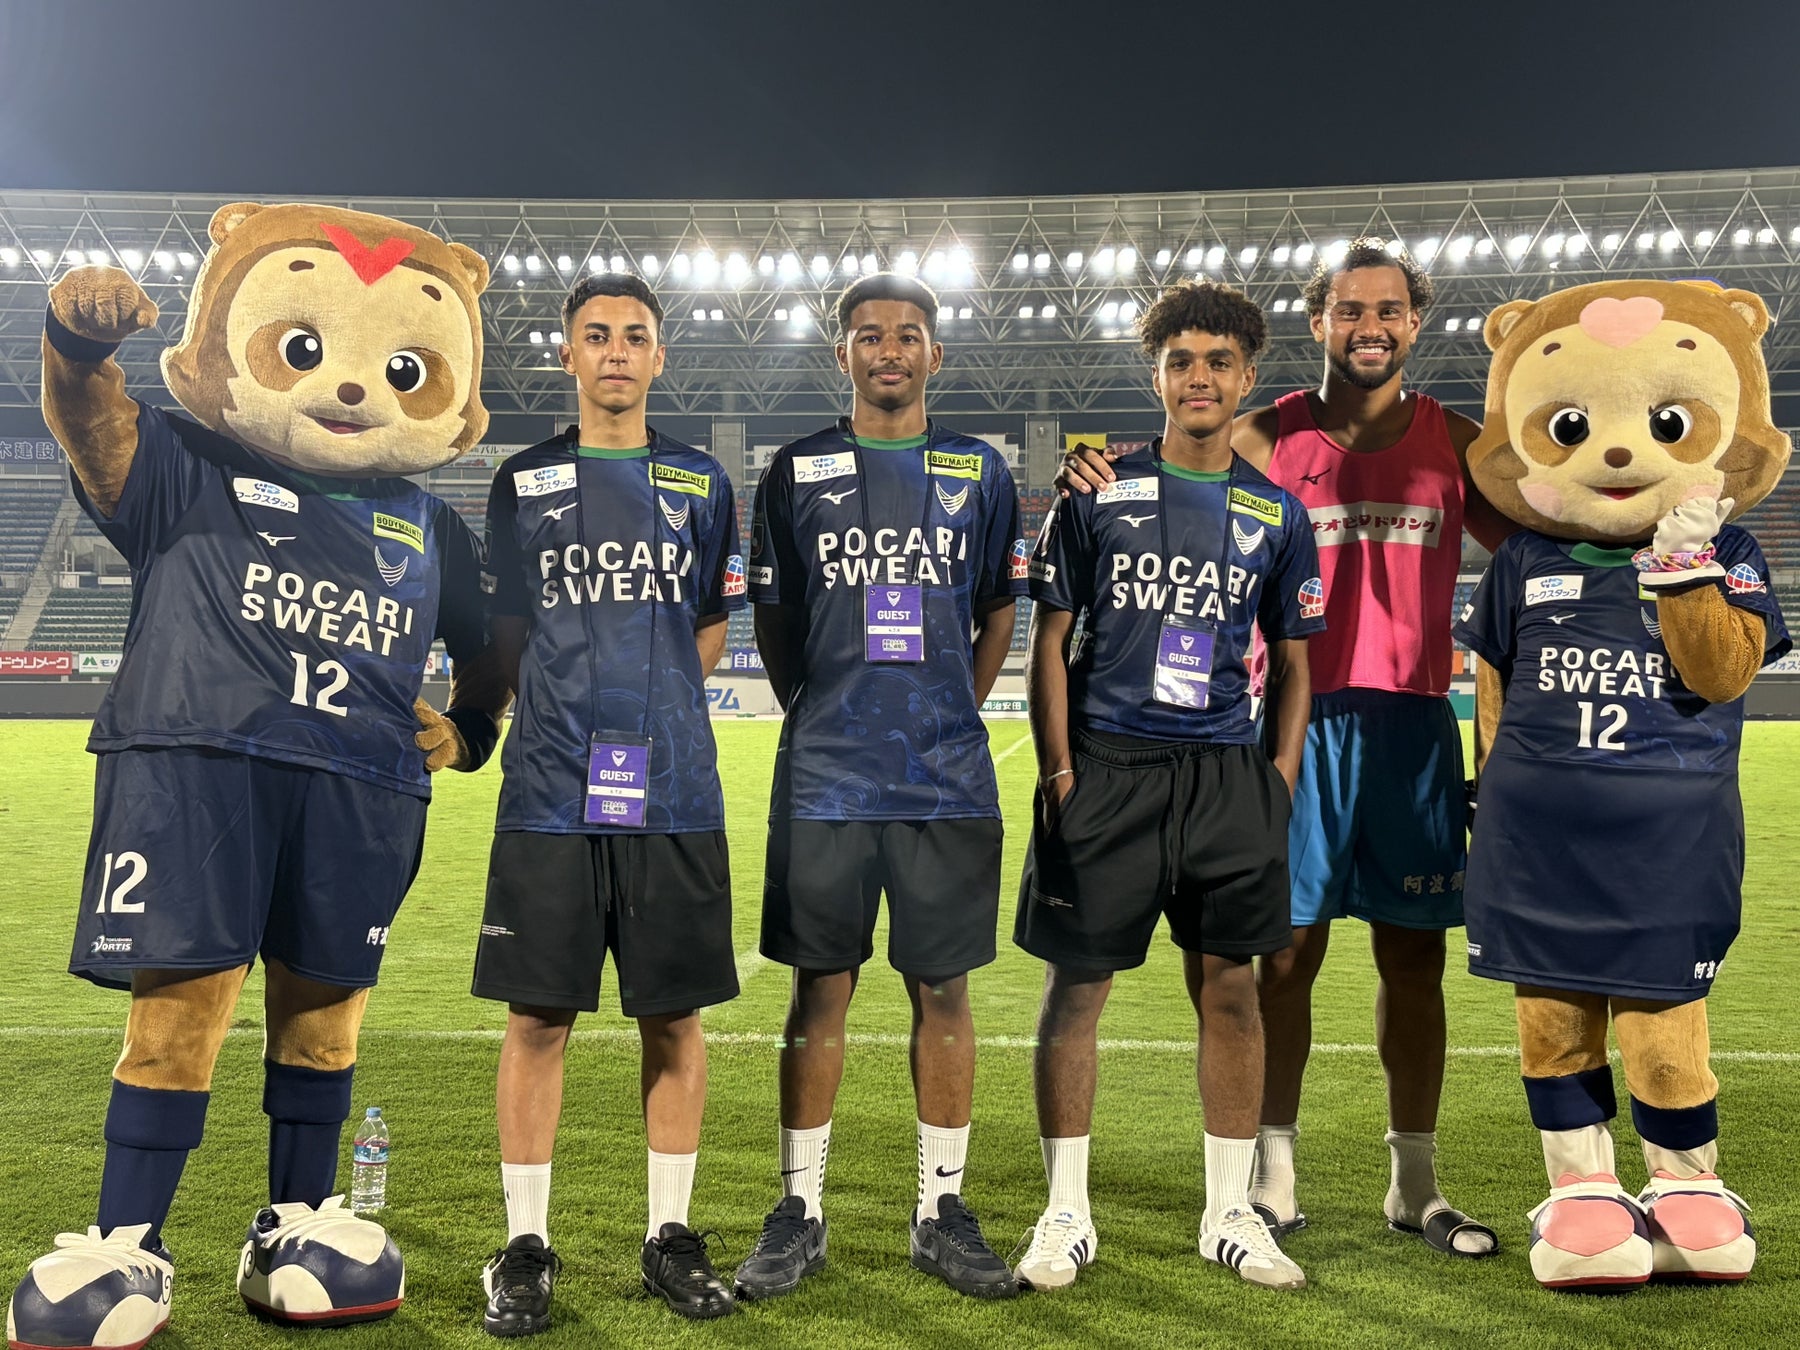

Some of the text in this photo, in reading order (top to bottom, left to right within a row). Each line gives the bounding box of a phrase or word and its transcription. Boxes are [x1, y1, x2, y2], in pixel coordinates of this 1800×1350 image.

[519, 477, 575, 493] ワークスタッフ
[652, 467, 706, 487] ODYMAINTÉ
[797, 465, 852, 480] ワークスタッフ
[1100, 490, 1156, 501] ワークスタッフ
[818, 527, 966, 562] POCARI
[539, 541, 693, 580] POCARI
[1111, 552, 1258, 599] POCARI
[244, 562, 413, 635] POCARI
[542, 572, 682, 609] SWEAT
[1527, 588, 1578, 602] ワークスタッフ
[241, 592, 399, 656] SWEAT
[877, 610, 911, 620] GUEST
[1168, 653, 1201, 667] GUEST
[290, 651, 349, 717] 12
[1538, 669, 1666, 699] SWEAT
[1577, 701, 1628, 750] 12
[600, 769, 635, 782] GUEST
[96, 851, 148, 914] 12
[91, 935, 132, 953] VORTIS
